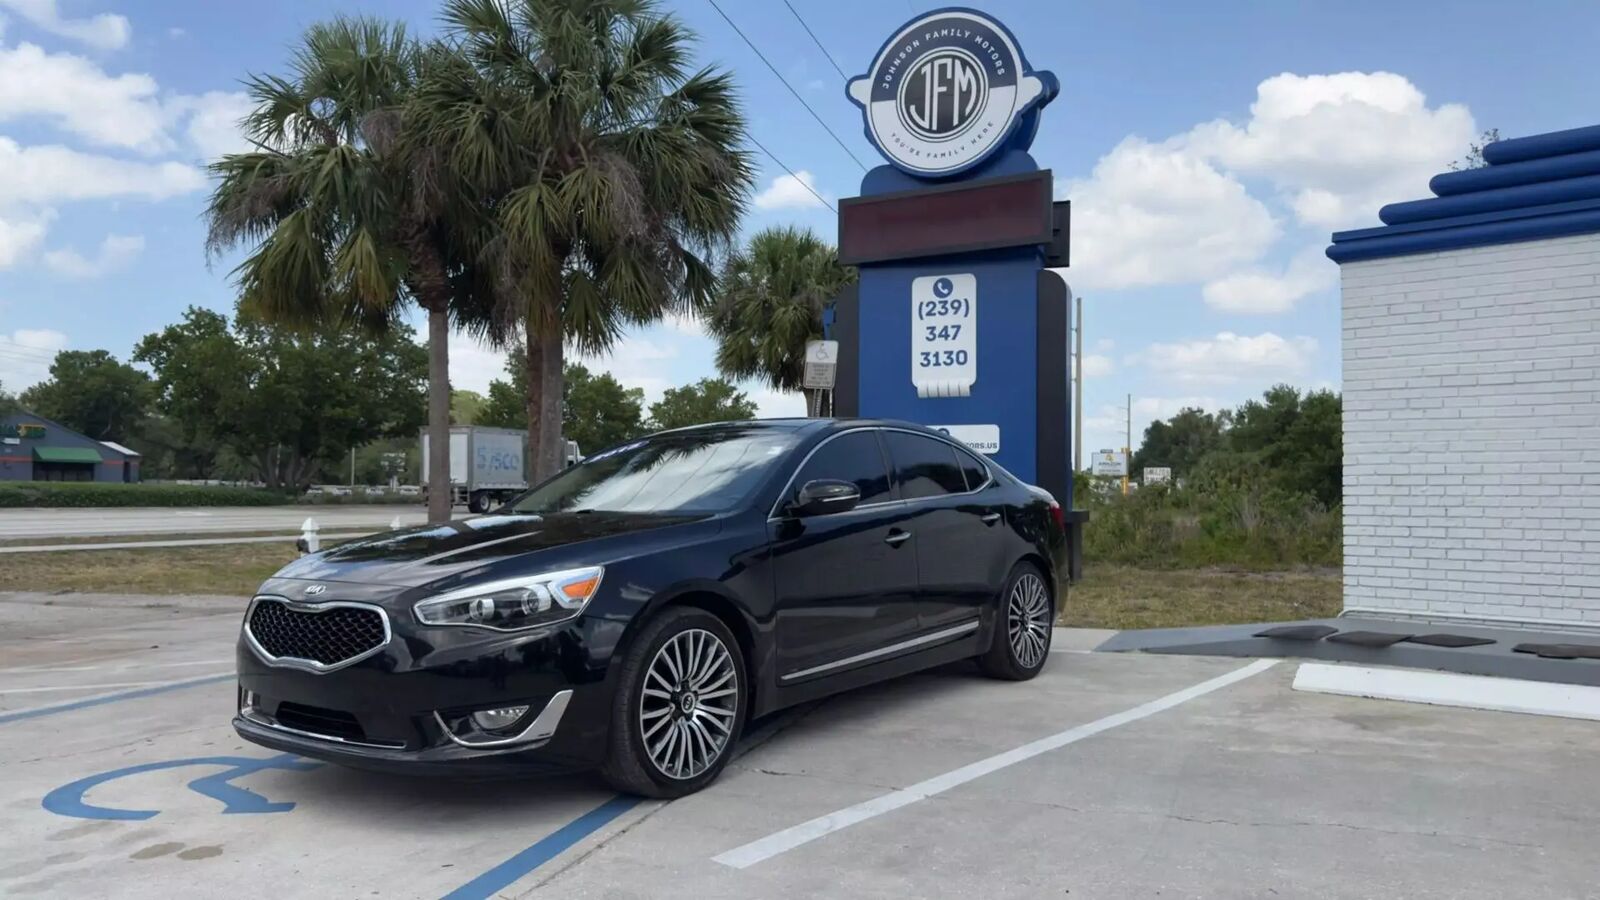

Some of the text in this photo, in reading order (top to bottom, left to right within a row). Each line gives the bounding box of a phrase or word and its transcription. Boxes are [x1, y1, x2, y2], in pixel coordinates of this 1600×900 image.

[882, 28, 1006, 89] JOHNSON FAMILY MOTORS
[909, 58, 977, 131] JFM
[926, 145, 966, 159] FAMILY
[918, 298, 970, 320] (239)
[925, 324, 962, 342] 347
[919, 349, 968, 368] 3130
